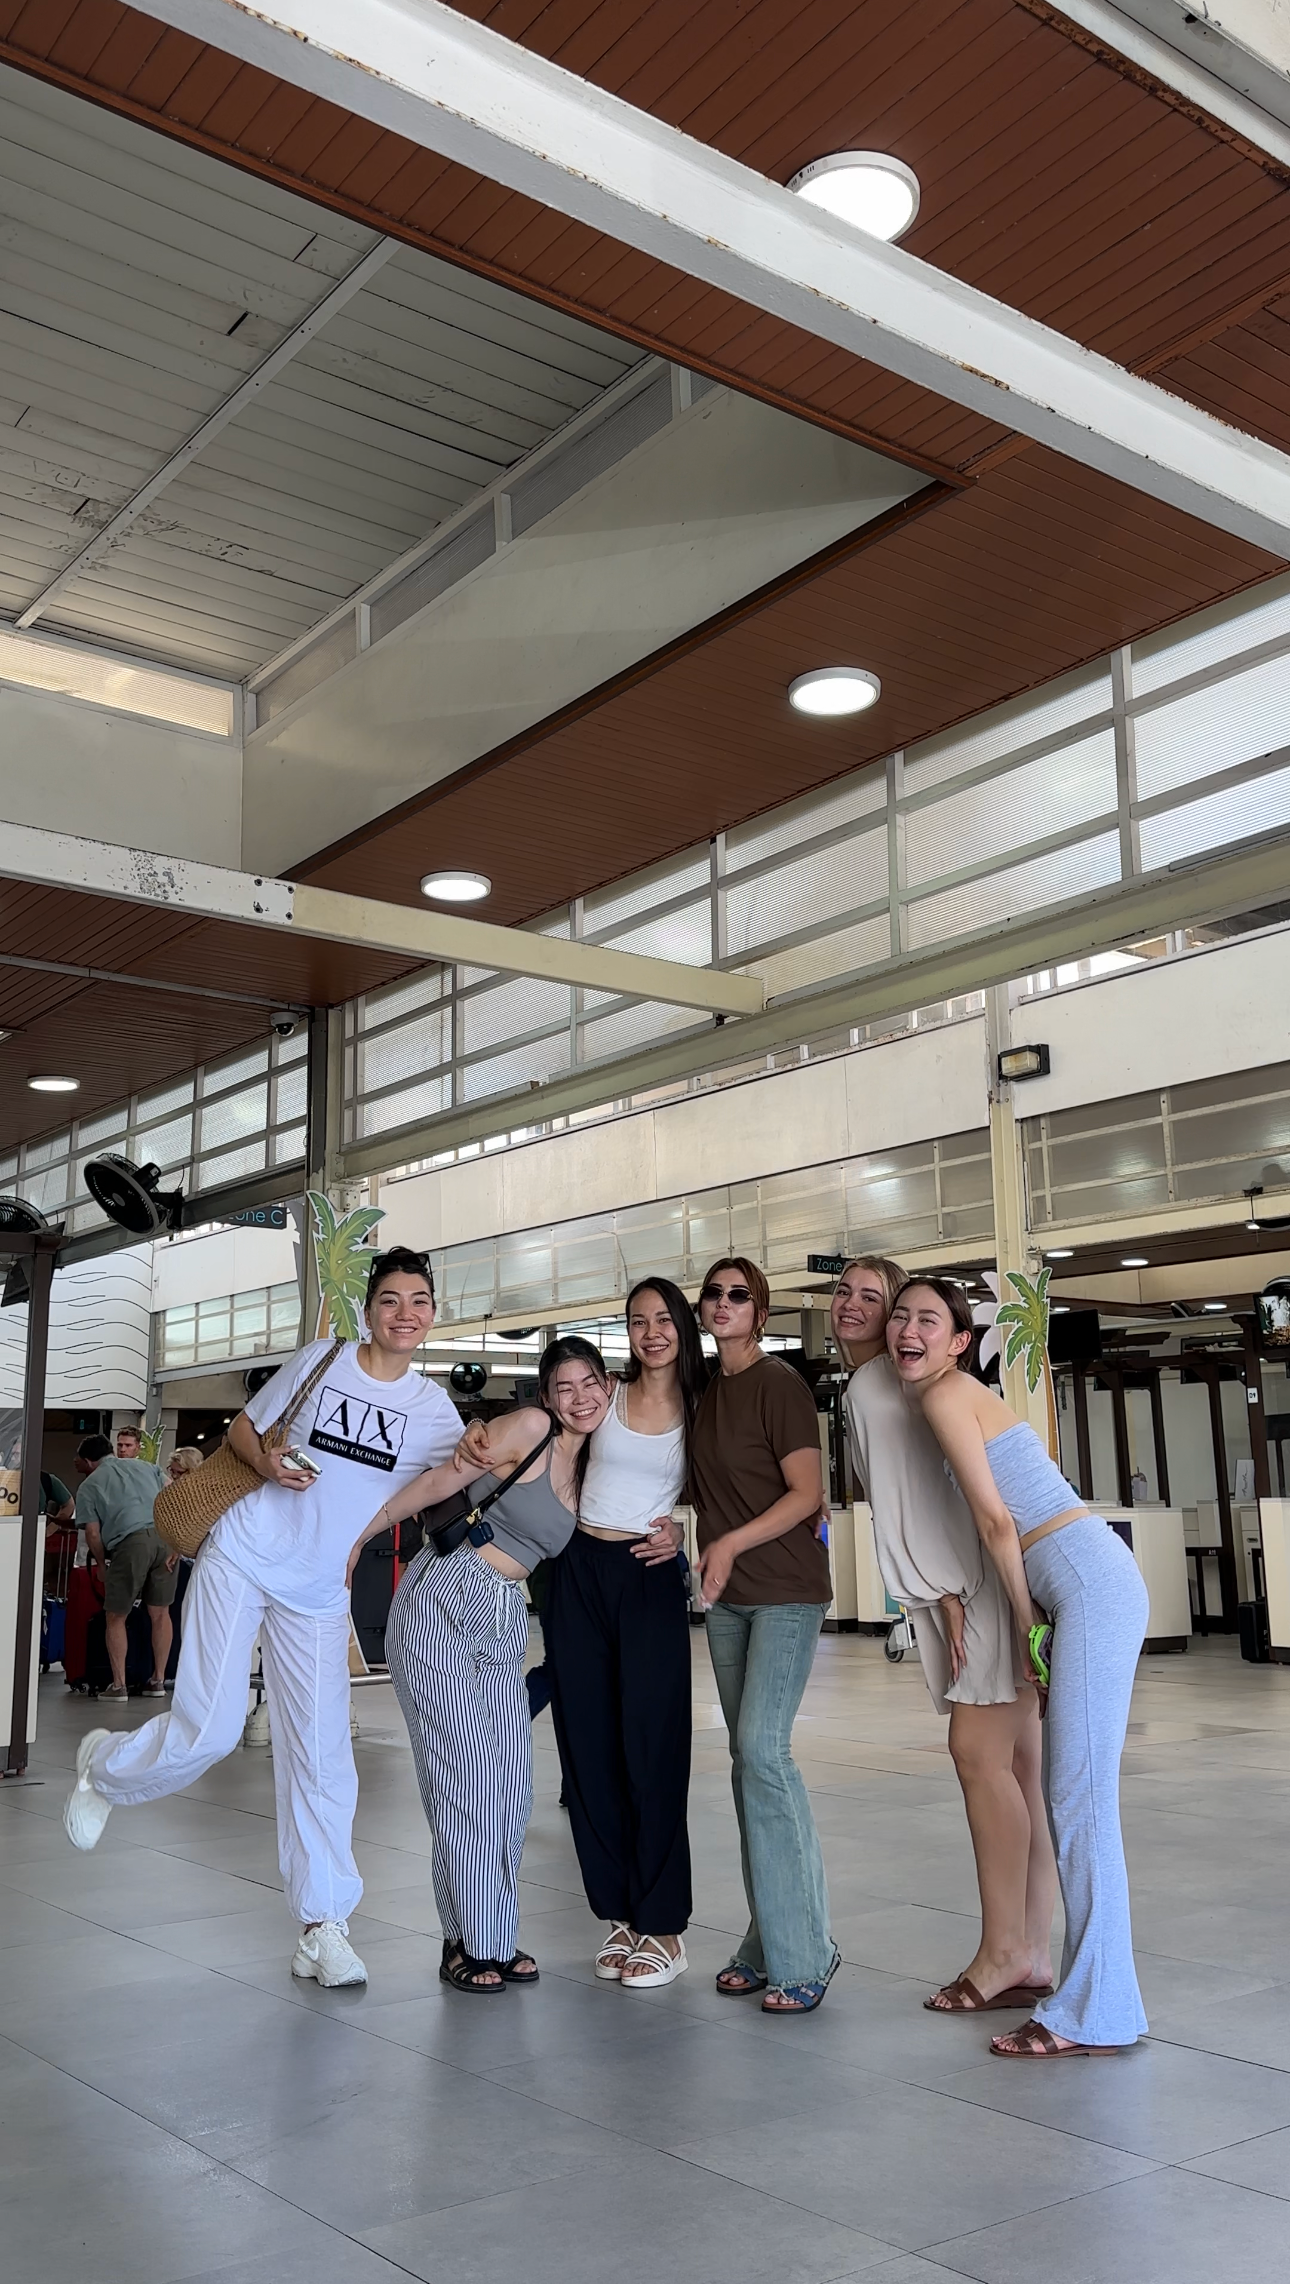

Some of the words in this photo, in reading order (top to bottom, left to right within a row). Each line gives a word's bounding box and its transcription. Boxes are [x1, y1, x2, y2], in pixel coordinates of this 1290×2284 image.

[229, 1210, 266, 1223] one
[270, 1209, 284, 1225] C
[816, 1257, 843, 1272] Zone
[315, 1436, 349, 1452] ARMANI
[349, 1447, 392, 1467] EXCHANGE
